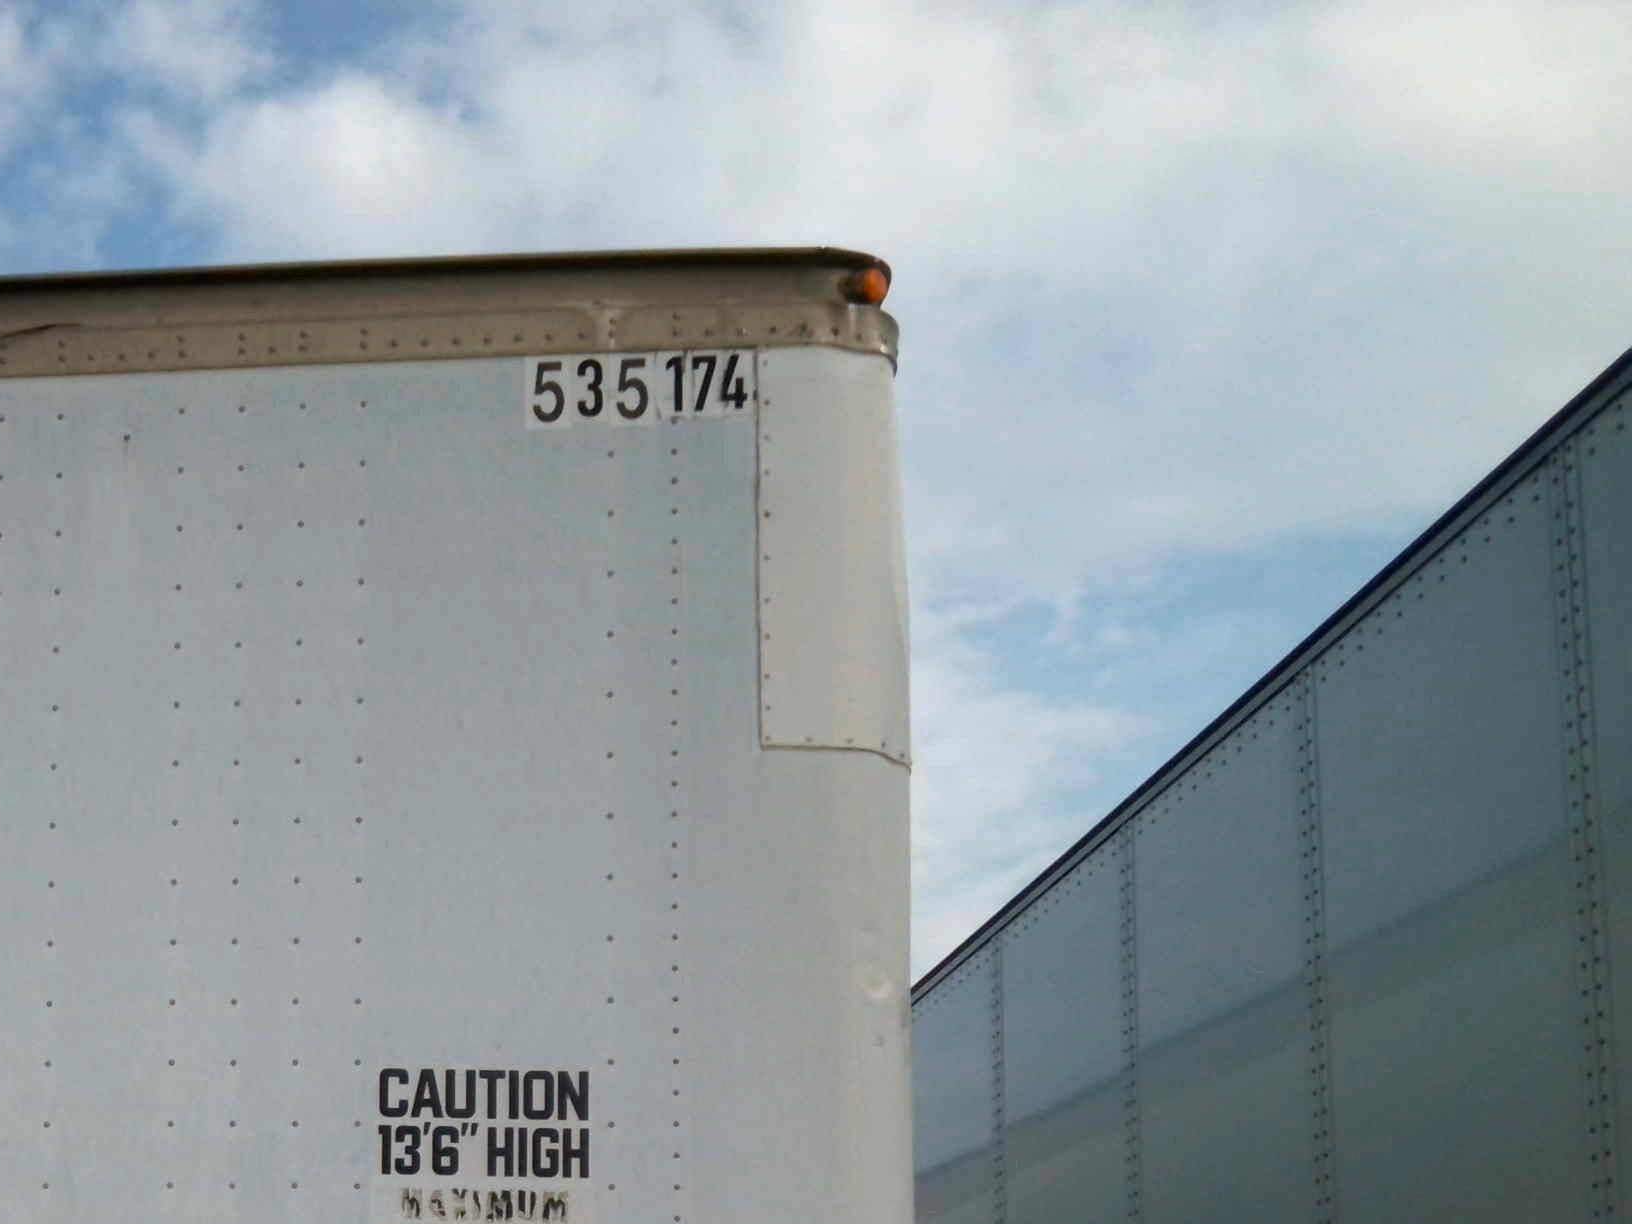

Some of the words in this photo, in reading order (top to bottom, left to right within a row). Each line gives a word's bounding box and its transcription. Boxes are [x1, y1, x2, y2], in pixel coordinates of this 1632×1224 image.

[532, 353, 748, 423] 535174
[378, 1067, 590, 1121] CAUTION
[377, 1121, 479, 1177] 13'6"
[486, 1126, 590, 1179] HIGH
